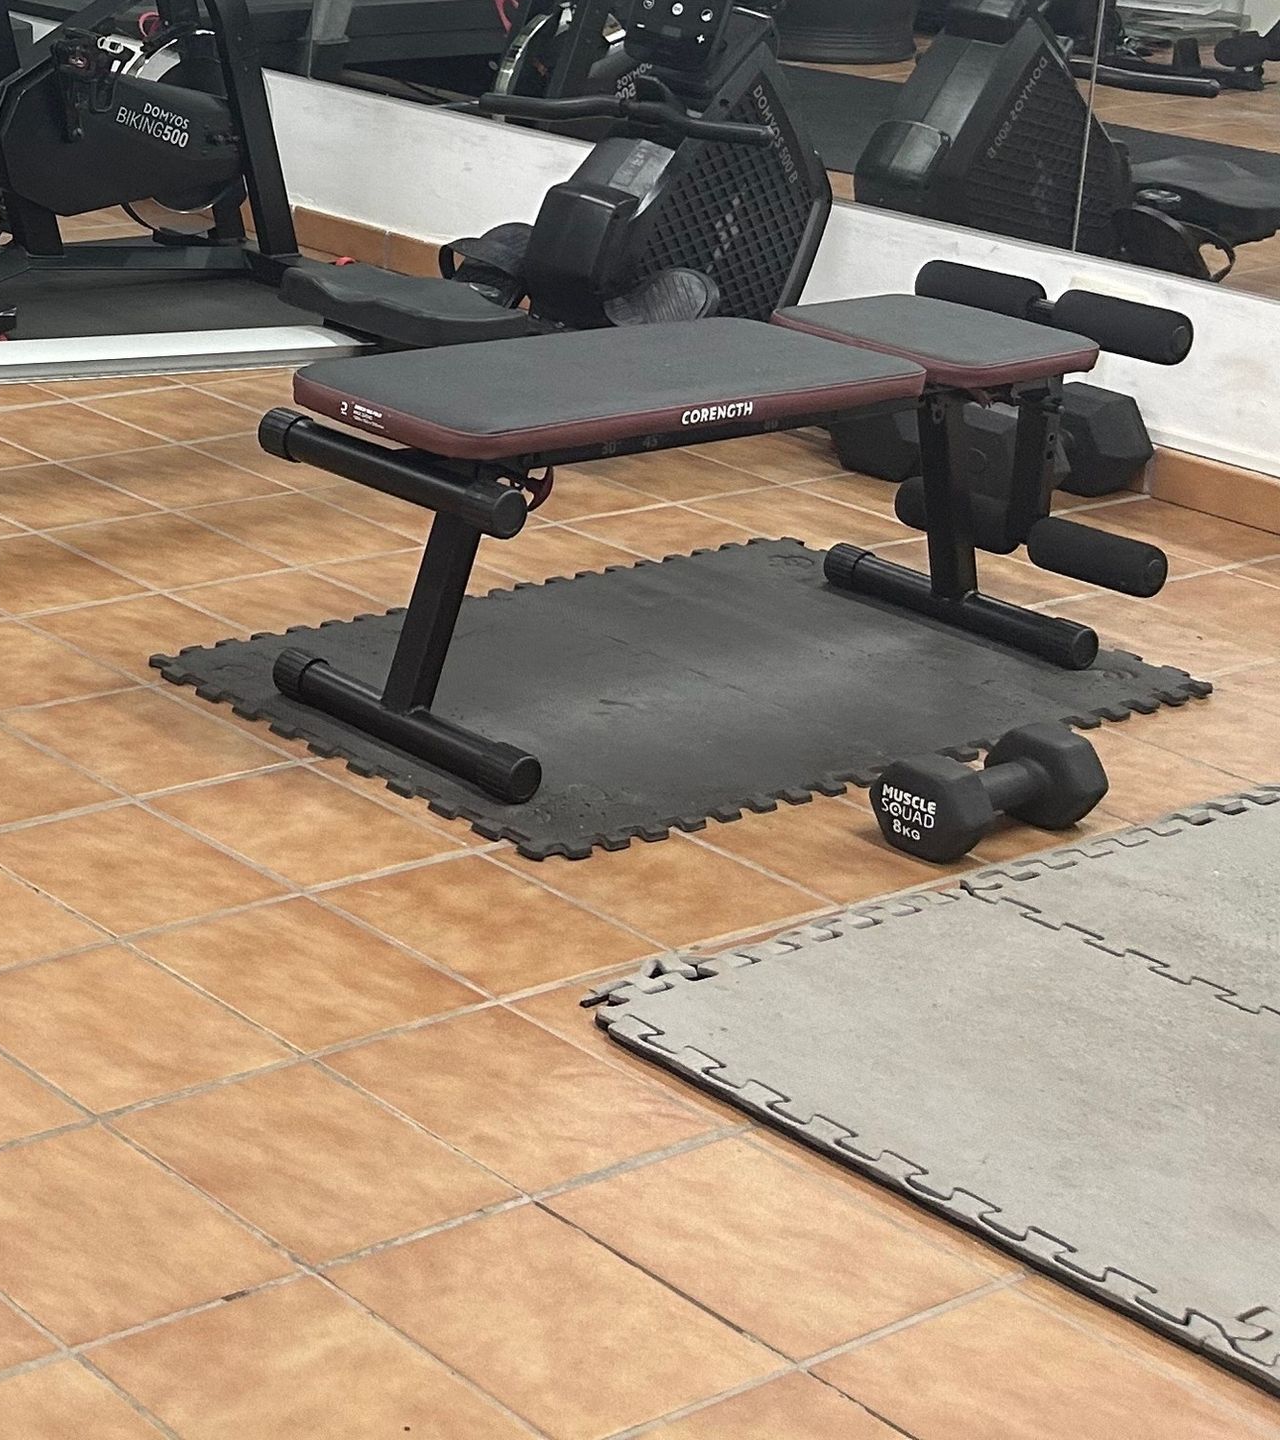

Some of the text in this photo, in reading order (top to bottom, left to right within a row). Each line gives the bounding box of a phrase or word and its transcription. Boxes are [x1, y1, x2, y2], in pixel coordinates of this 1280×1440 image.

[115, 106, 190, 148] BIKING500
[143, 102, 190, 130] DOMYOS
[681, 401, 754, 426] CORENGTH
[881, 783, 937, 816] MUSCLE
[881, 797, 935, 829] SQUAD
[892, 818, 922, 841] 8KG
